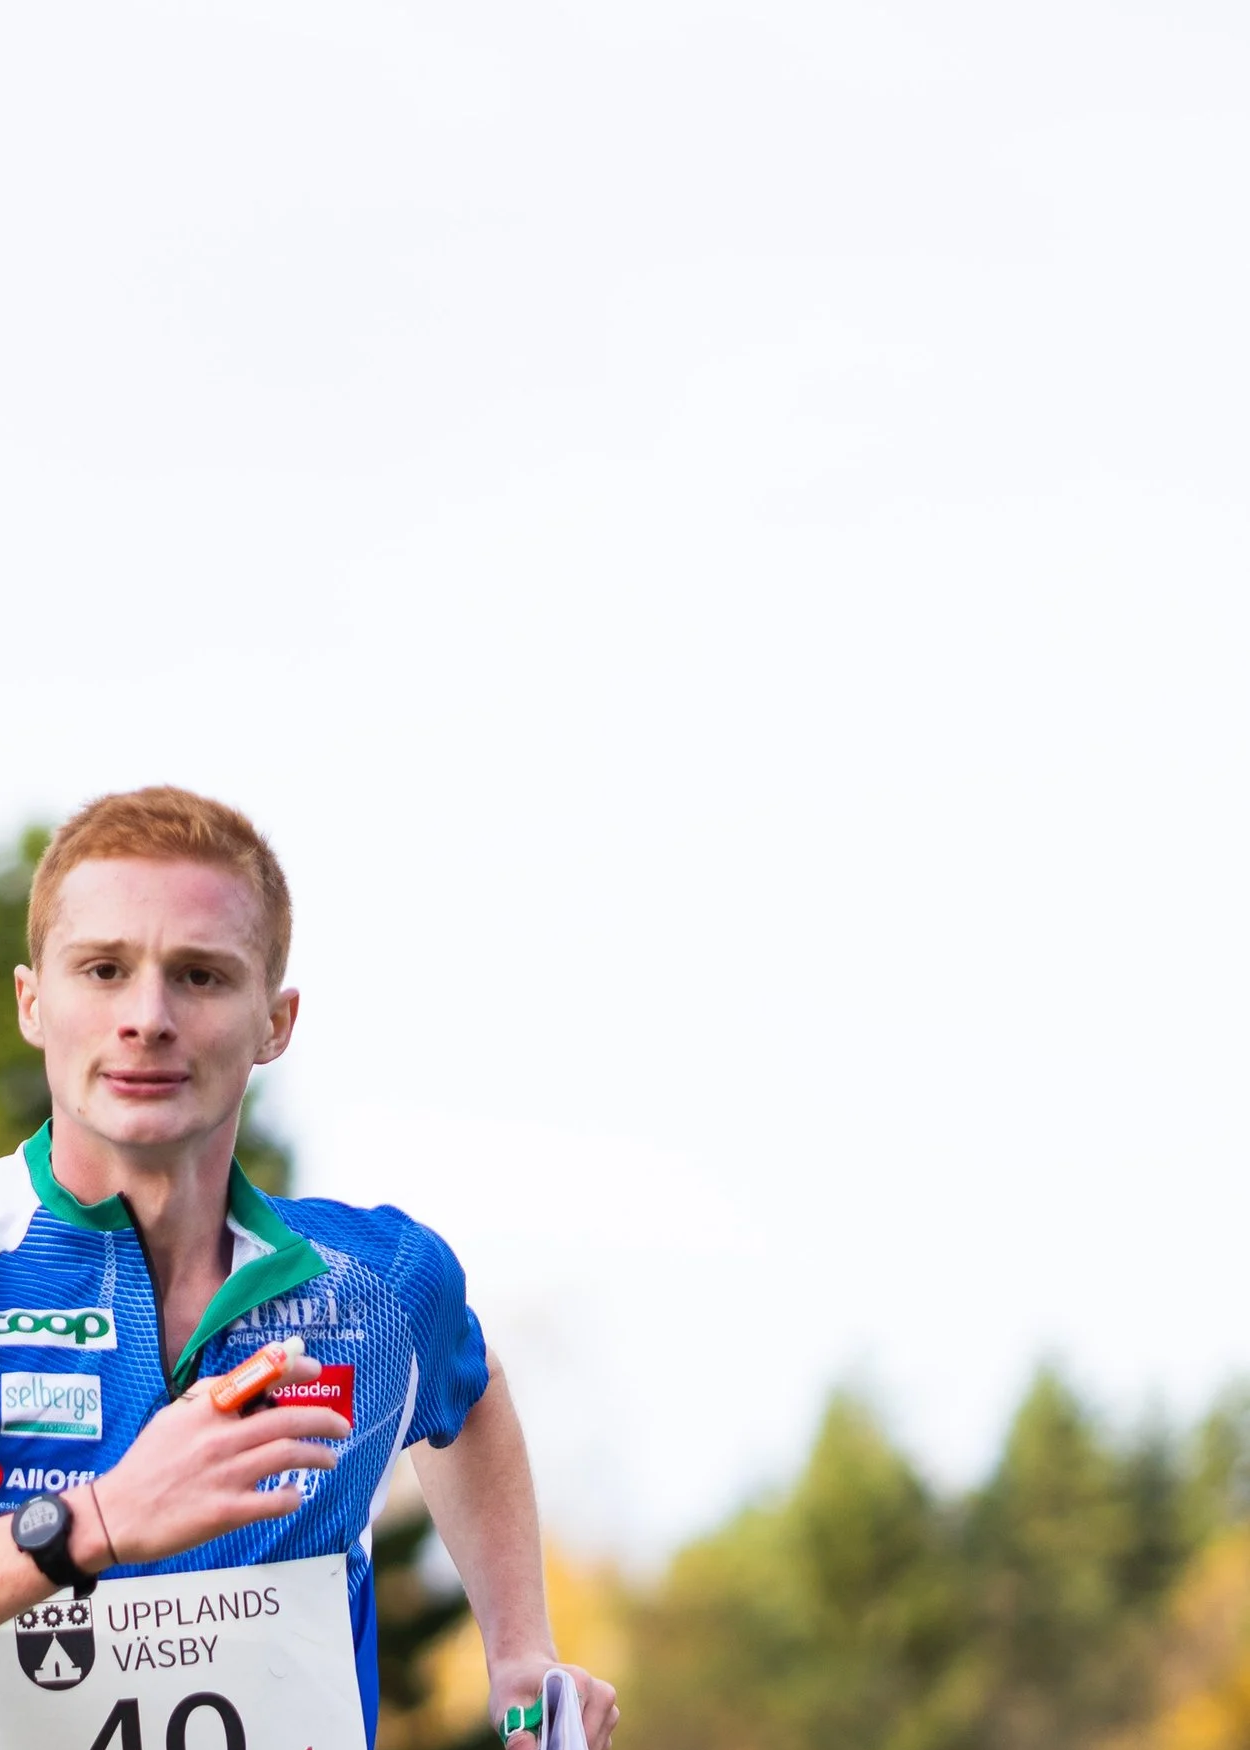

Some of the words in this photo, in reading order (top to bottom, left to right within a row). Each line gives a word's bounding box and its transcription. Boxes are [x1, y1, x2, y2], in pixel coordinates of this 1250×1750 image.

[5, 1376, 98, 1420] selbergs
[270, 1381, 341, 1398] ostaden
[108, 1586, 280, 1632] UPPLANDS
[112, 1634, 218, 1672] VÄSBY
